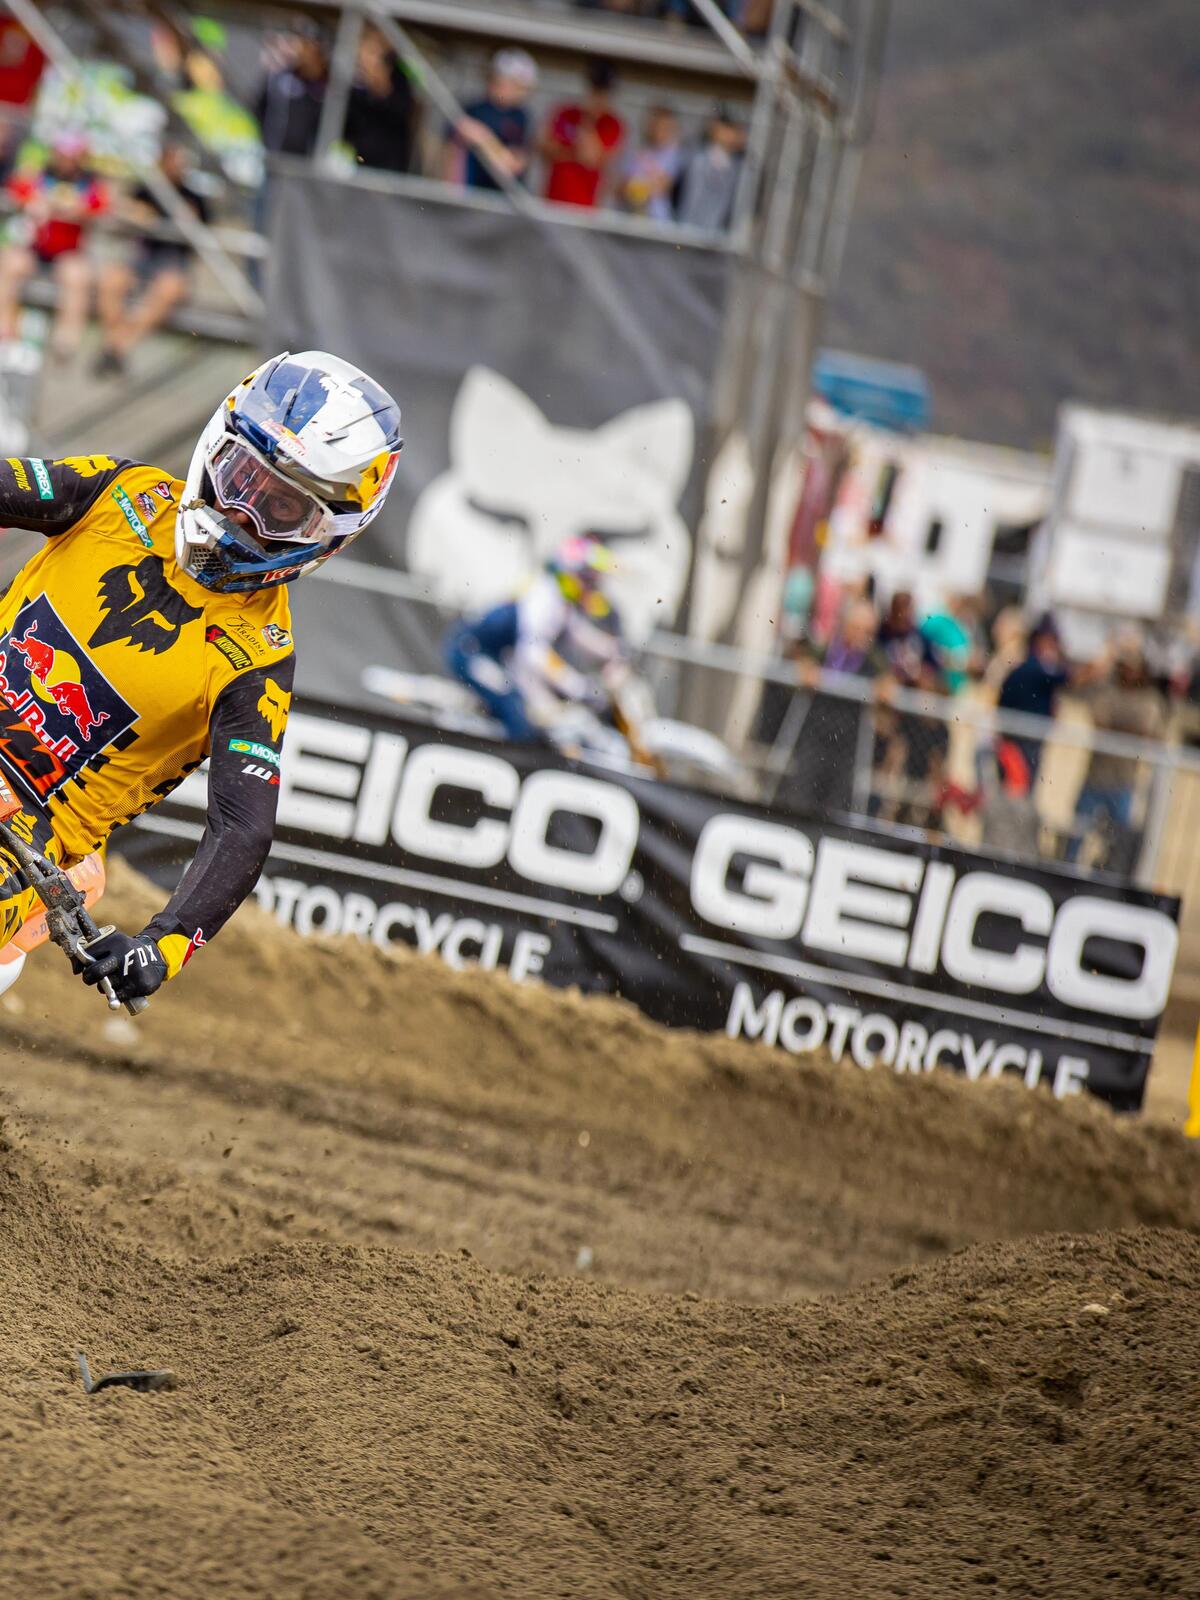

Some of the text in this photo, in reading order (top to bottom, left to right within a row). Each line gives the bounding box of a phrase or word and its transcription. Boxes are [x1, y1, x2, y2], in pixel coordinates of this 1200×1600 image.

[161, 709, 640, 895] EICO
[123, 944, 158, 977] FOX
[690, 813, 1179, 1020] GEICO
